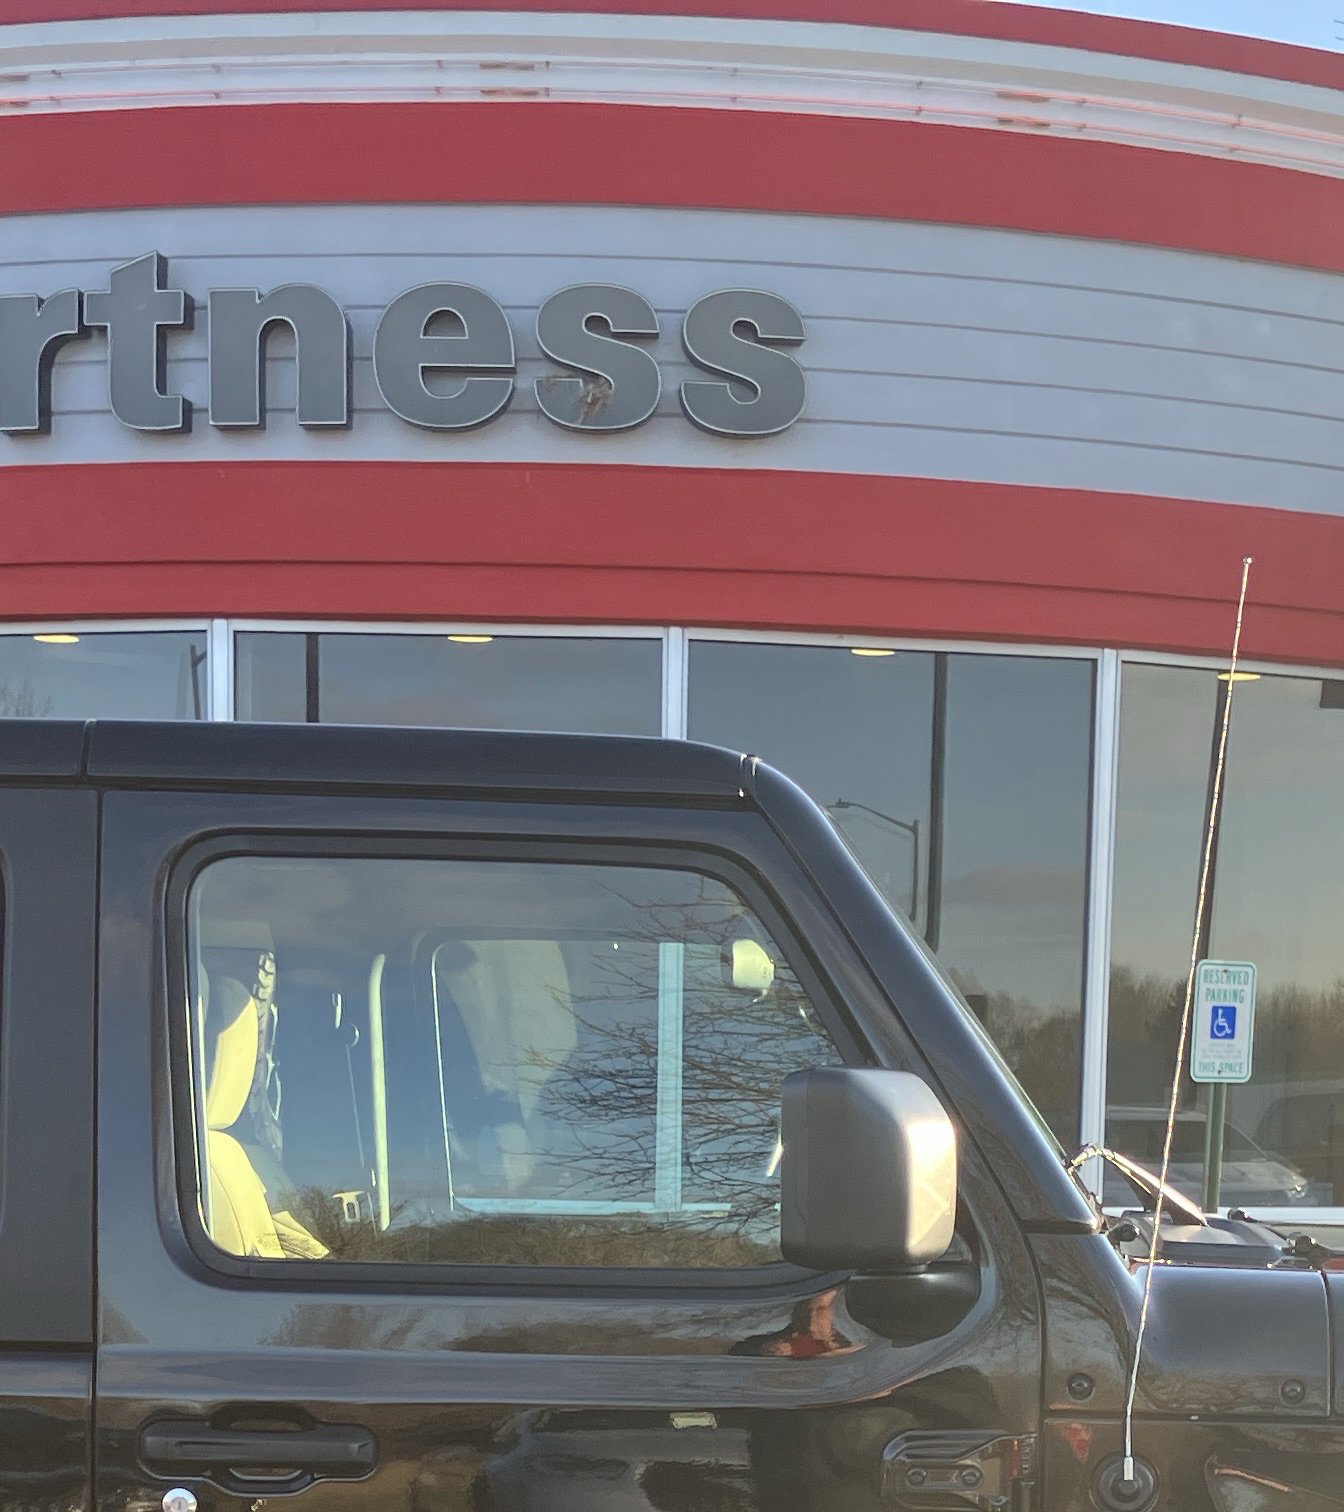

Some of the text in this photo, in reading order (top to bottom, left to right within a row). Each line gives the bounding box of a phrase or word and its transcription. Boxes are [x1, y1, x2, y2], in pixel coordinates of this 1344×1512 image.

[1202, 968, 1250, 986] RESERVED
[1205, 987, 1245, 1003] PARKING
[1197, 1061, 1245, 1074] THIS SPACE
